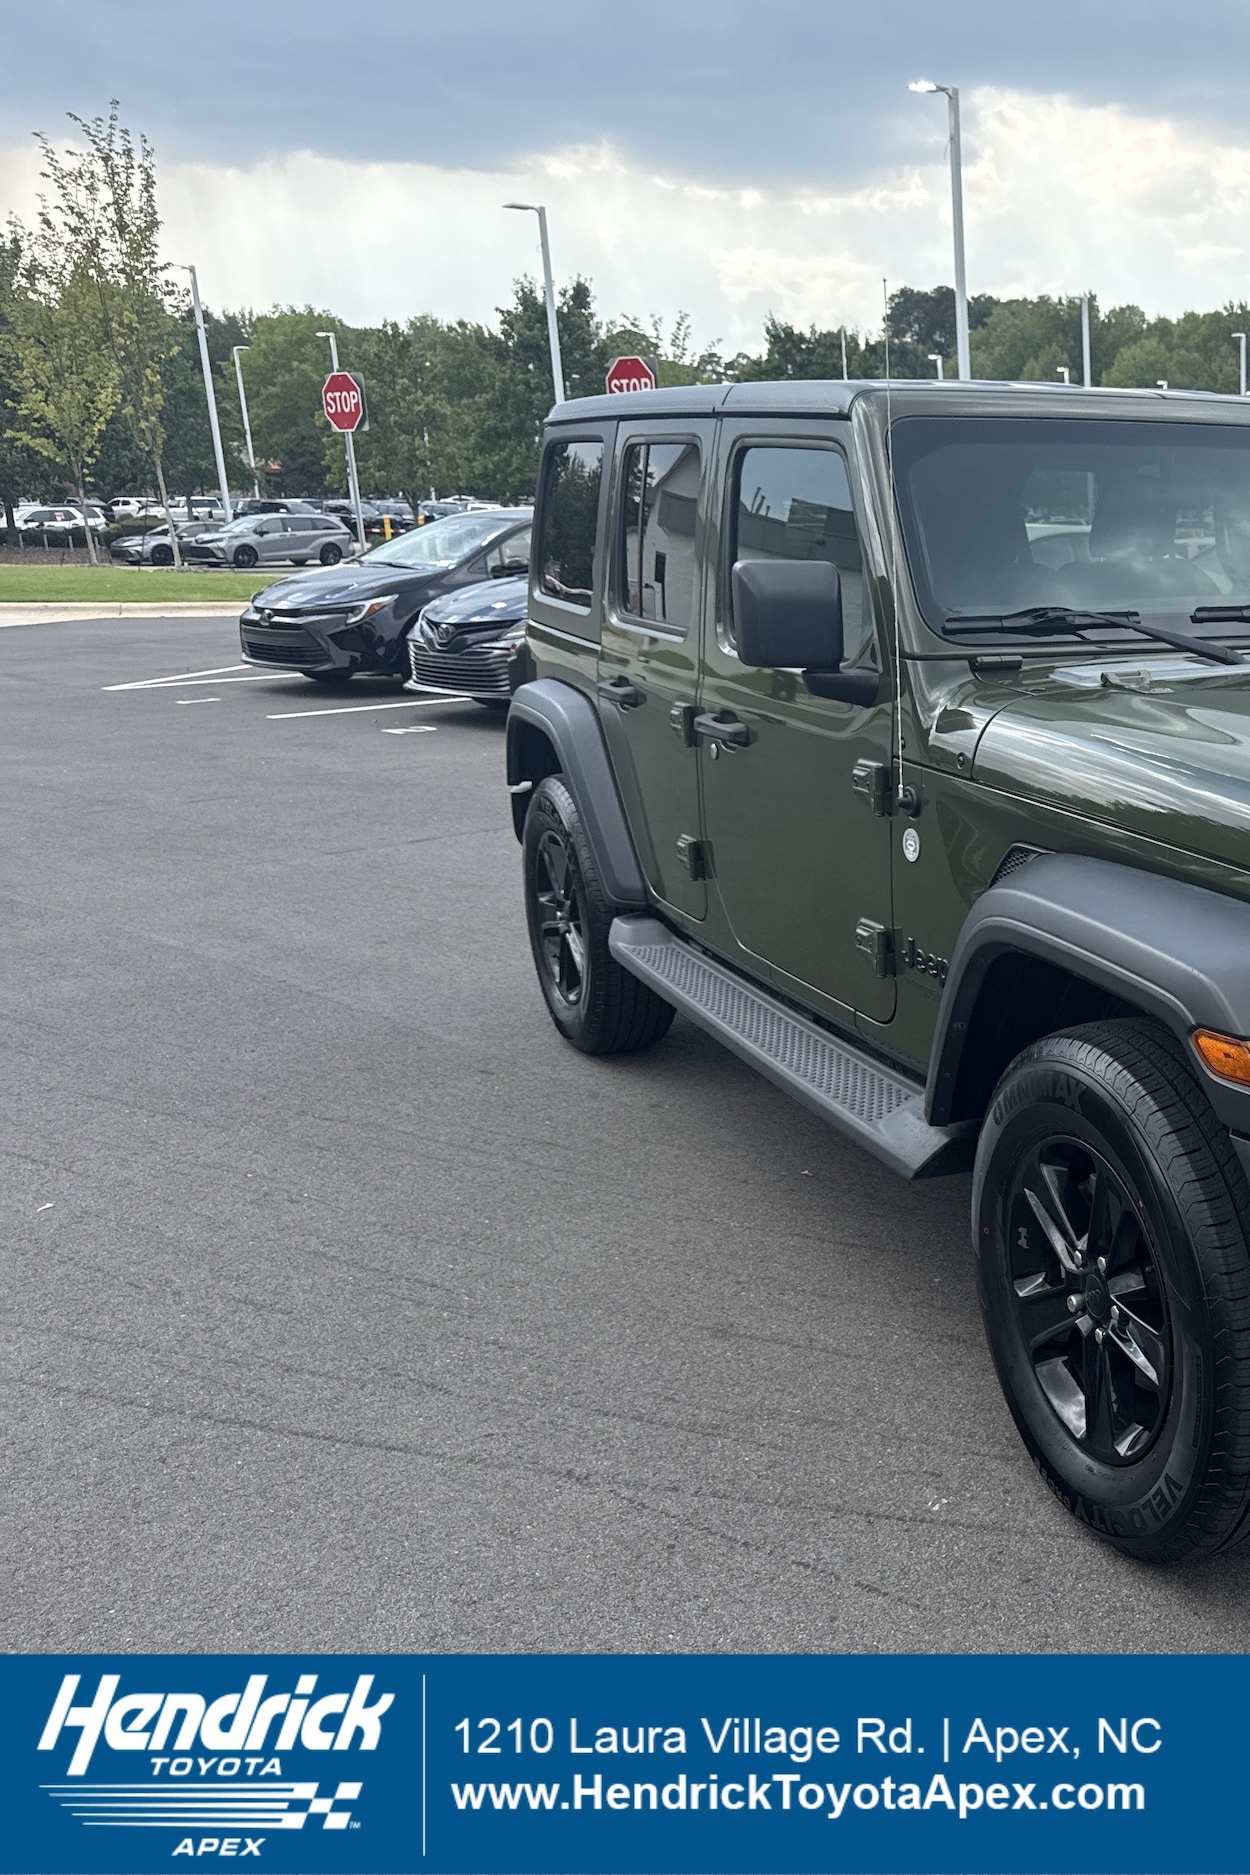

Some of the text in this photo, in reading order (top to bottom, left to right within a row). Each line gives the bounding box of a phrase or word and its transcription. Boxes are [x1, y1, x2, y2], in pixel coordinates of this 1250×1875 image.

[326, 390, 358, 414] STOP
[901, 936, 949, 988] Jeep
[993, 1068, 1087, 1126] OMNIMAX
[1074, 1472, 1184, 1534] VELOCITY
